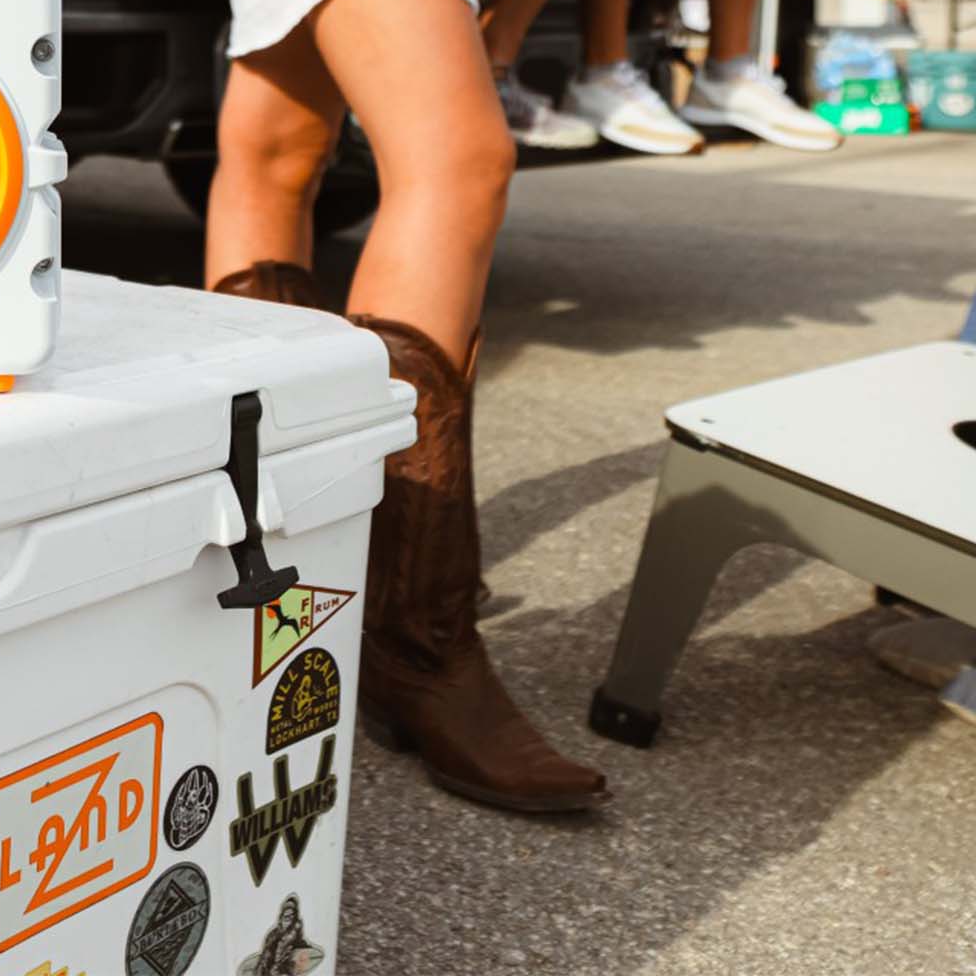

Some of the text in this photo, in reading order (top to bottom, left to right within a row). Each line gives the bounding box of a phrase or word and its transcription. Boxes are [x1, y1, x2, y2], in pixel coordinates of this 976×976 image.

[271, 652, 338, 721] MILL SCALE
[232, 777, 337, 852] WILLIAMS
